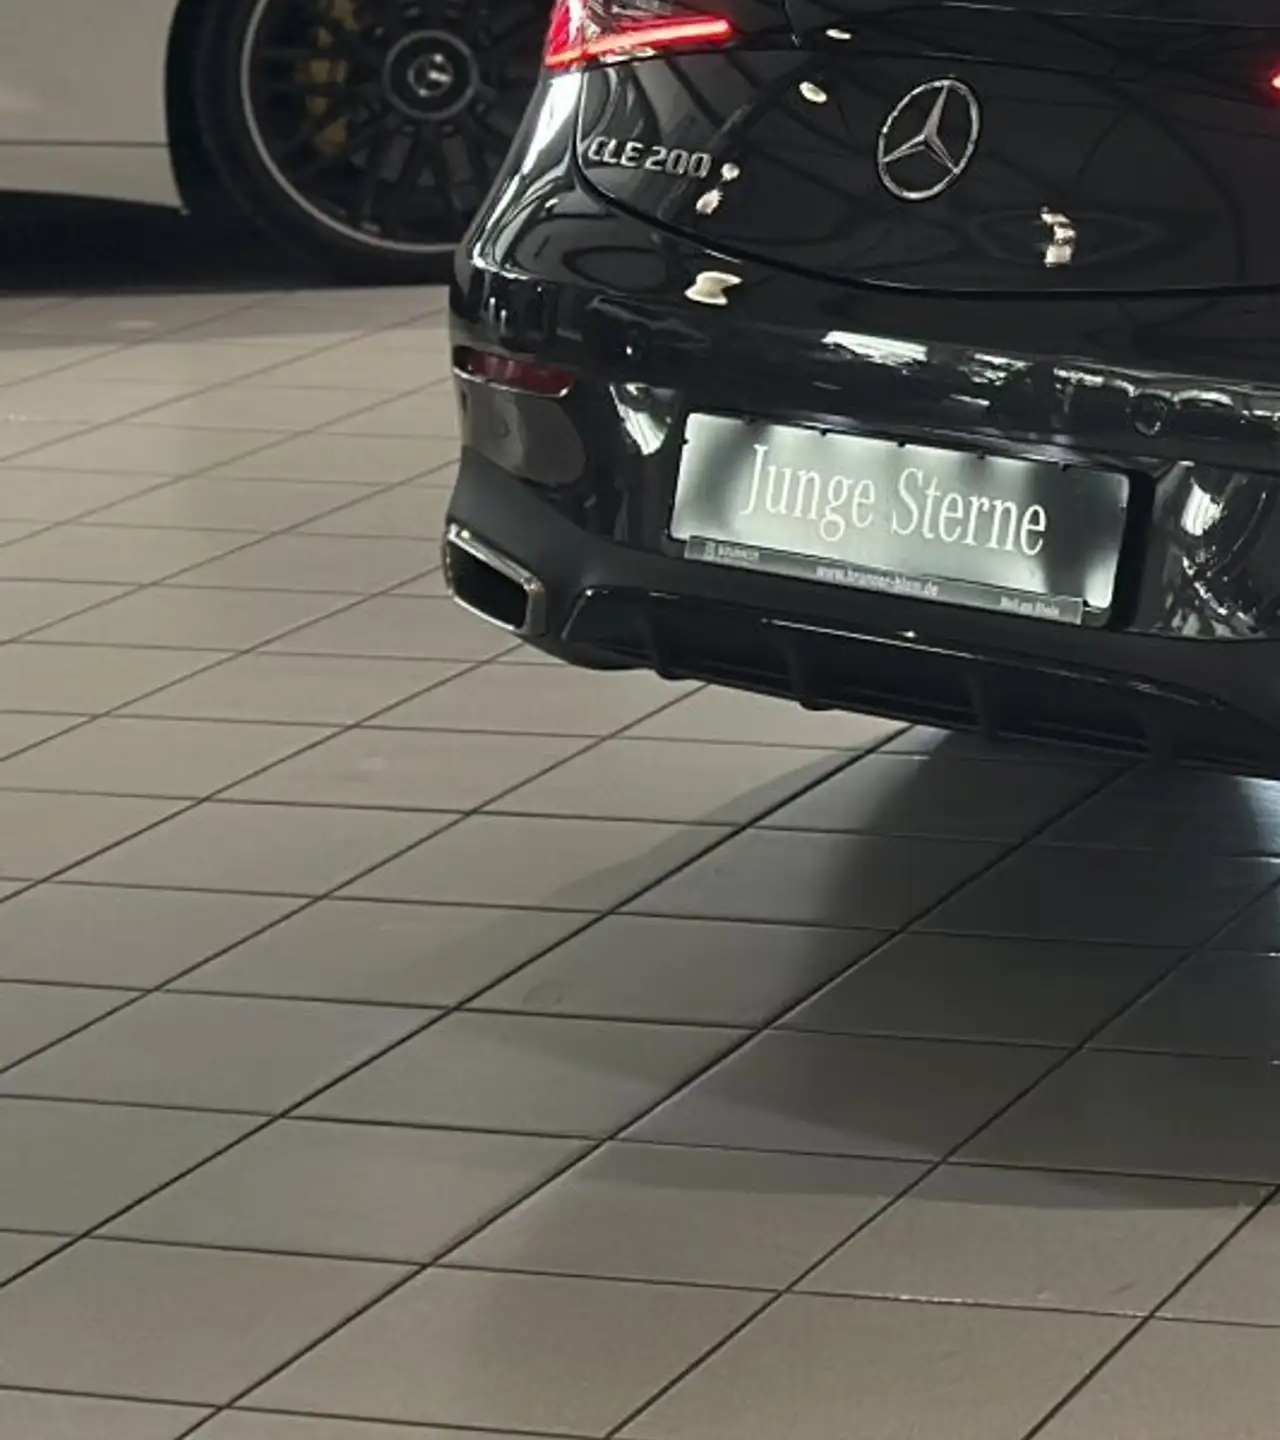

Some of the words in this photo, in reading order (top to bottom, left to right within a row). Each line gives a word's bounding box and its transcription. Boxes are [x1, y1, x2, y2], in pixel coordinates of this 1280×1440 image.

[588, 136, 644, 167] CLE
[644, 145, 712, 179] 200
[739, 444, 876, 542] Junge
[891, 467, 1047, 556] Sterne
